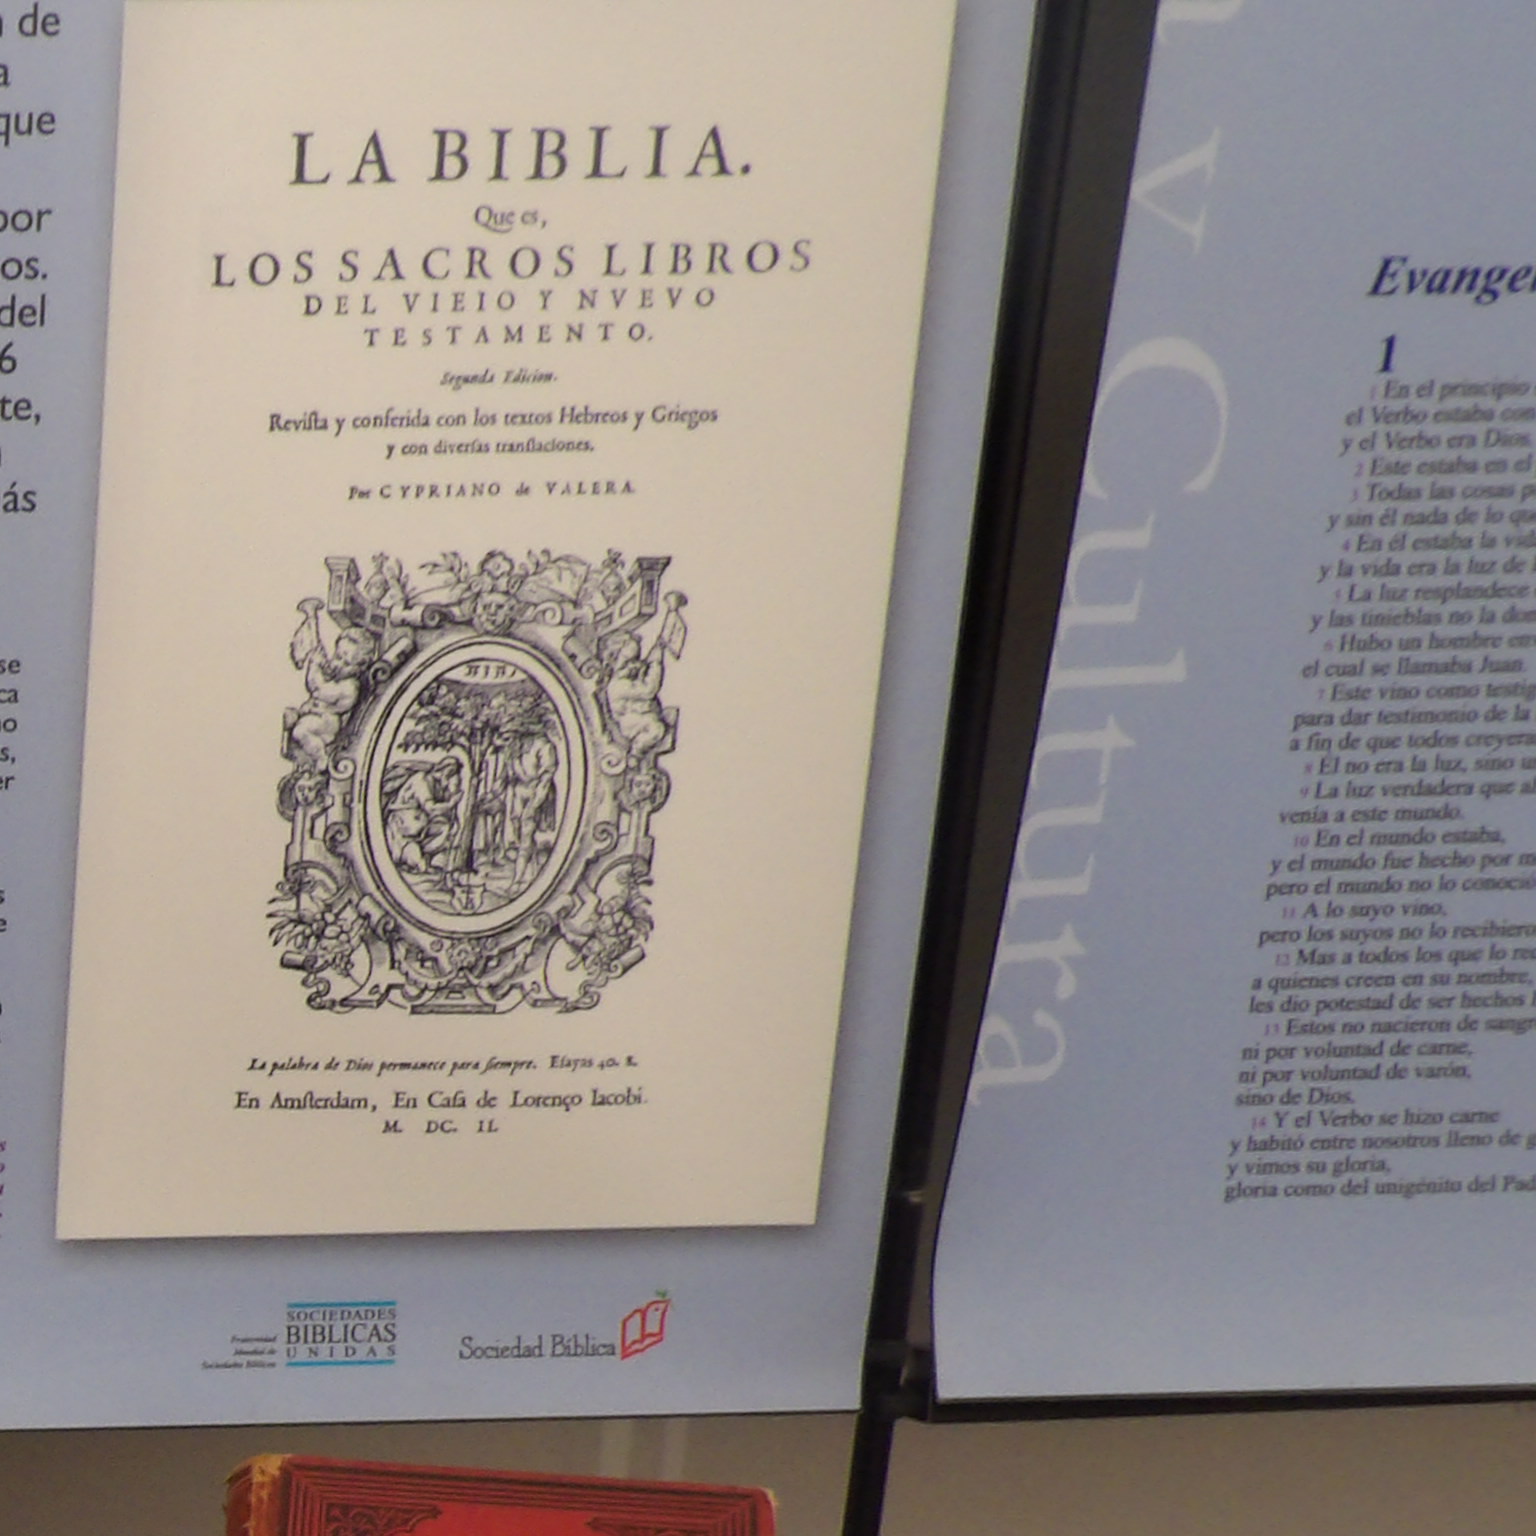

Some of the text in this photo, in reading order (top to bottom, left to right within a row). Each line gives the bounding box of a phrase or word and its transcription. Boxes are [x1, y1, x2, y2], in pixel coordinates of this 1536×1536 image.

[17, 1, 61, 38] de
[288, 124, 752, 186] LA BIBLIA.
[472, 204, 548, 235] Que es,
[211, 239, 811, 289] LOS SACROS LIBROS
[302, 286, 716, 318] DEL VIEIO Y NVEVO
[363, 321, 654, 348] TESTAMENTO.
[1378, 334, 1396, 373] 1
[333, 403, 719, 438] y conferida con los textos Hebreos y Griegos
[973, 336, 1227, 1105] Cultura
[286, 1309, 396, 1322] SOCIEDADES
[286, 1324, 396, 1344] BIBLICAS
[458, 1332, 616, 1361] Sociedad Bíblica
[286, 1347, 396, 1358] UNIDAS
